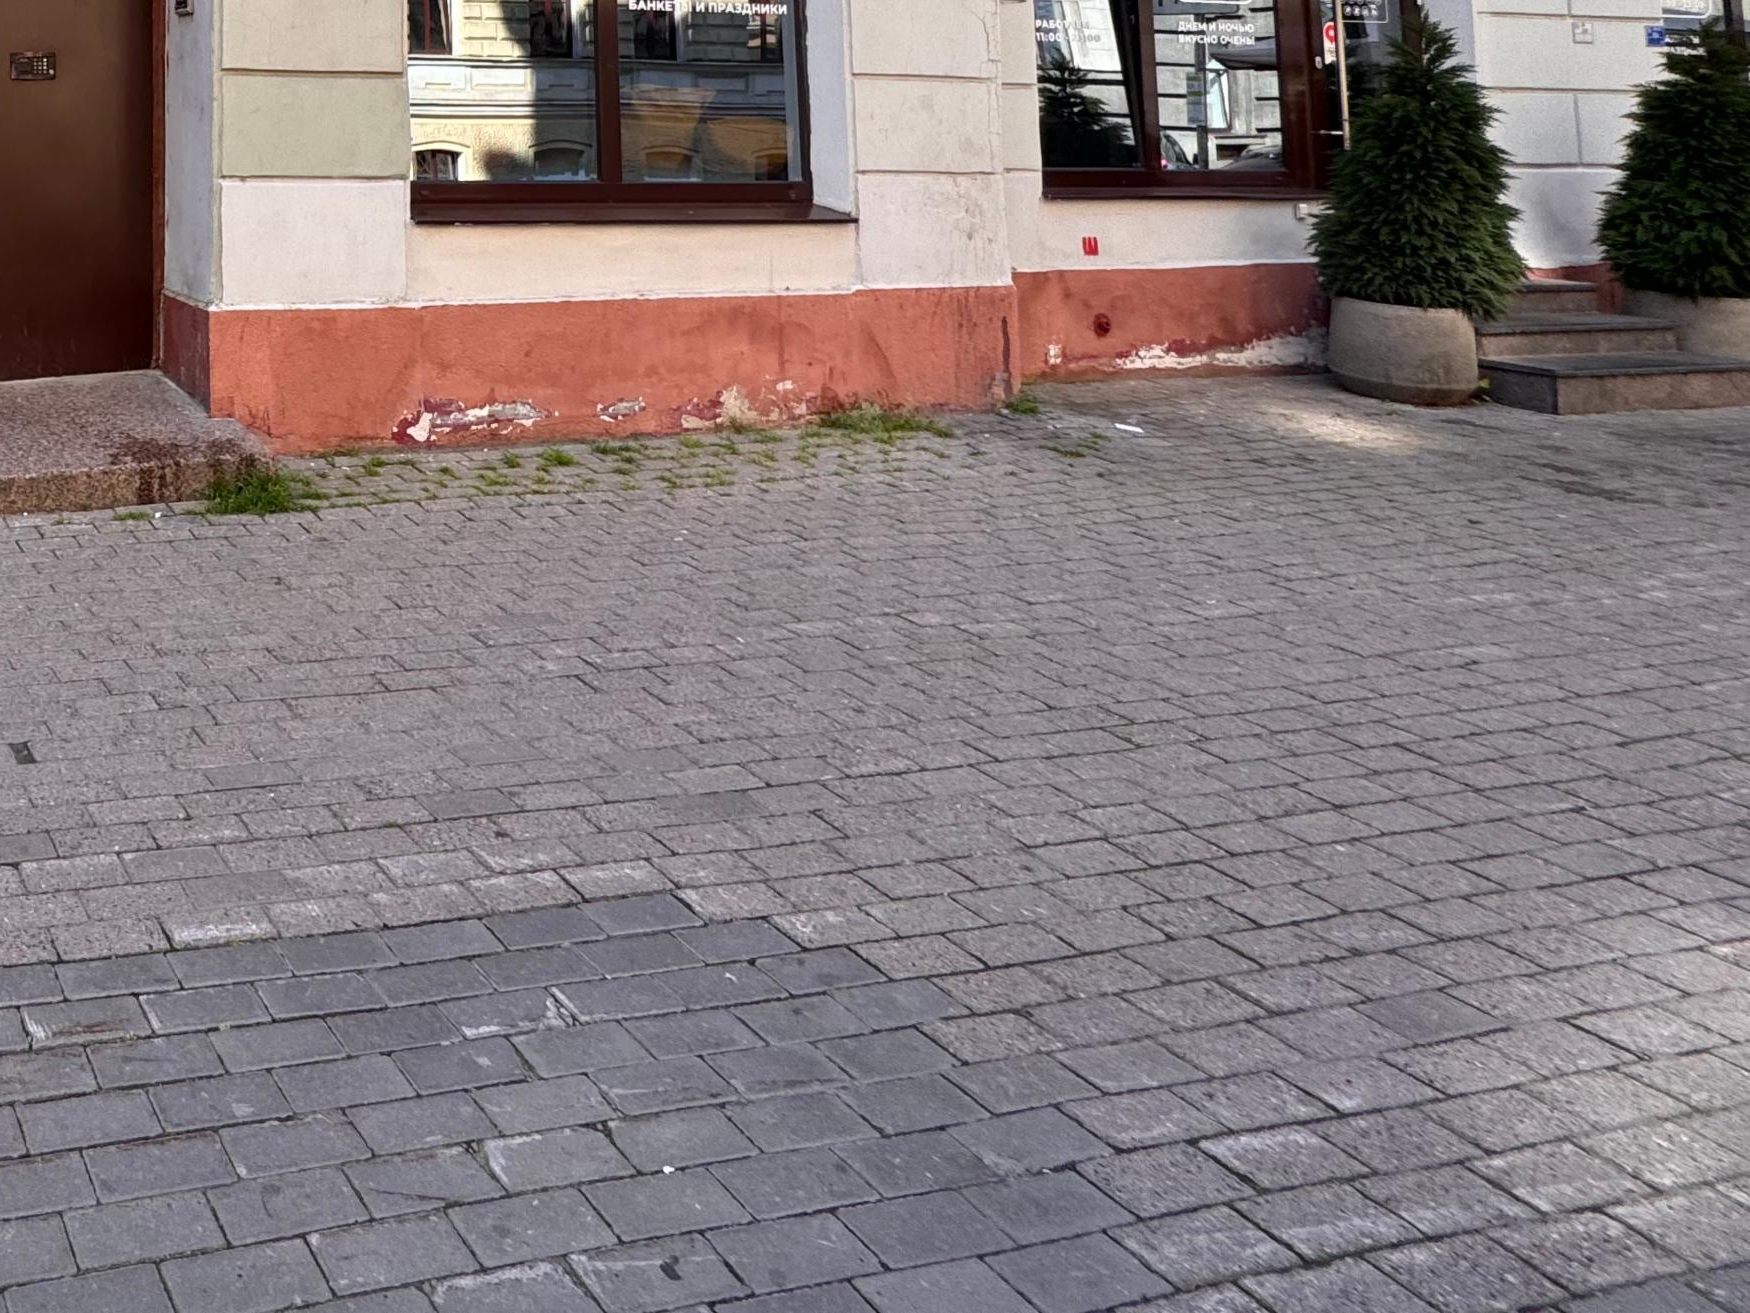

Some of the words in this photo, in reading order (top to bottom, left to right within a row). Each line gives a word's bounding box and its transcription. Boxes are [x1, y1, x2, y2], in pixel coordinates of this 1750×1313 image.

[628, 0, 692, 12] БАНКЕТЫ
[695, 1, 705, 12] И
[708, 1, 788, 15] ПРАЗДНИКИ
[1178, 21, 1207, 32] ДНЕМ
[1208, 22, 1216, 32] И
[1218, 23, 1254, 33] НОЧЬЮ
[1035, 32, 1061, 42] 11:00
[1178, 34, 1218, 44] ВКУСНО
